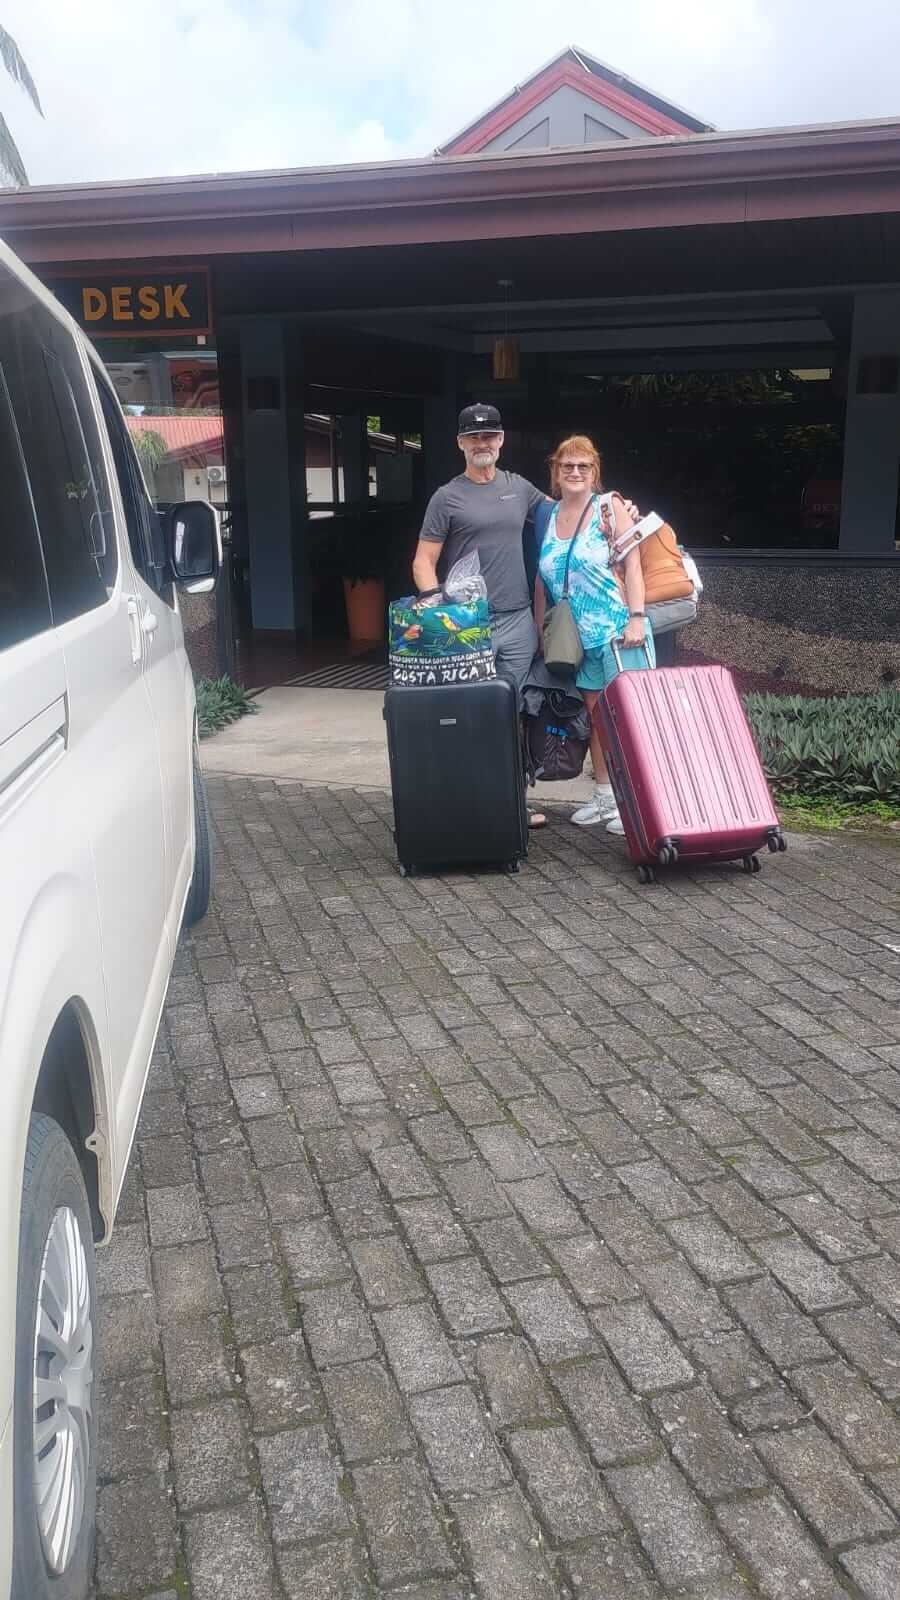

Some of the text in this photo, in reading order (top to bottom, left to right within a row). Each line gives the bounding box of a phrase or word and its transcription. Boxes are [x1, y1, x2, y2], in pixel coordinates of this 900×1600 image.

[82, 284, 190, 321] DESK
[393, 668, 436, 685] COSTA
[441, 666, 480, 683] RICA
